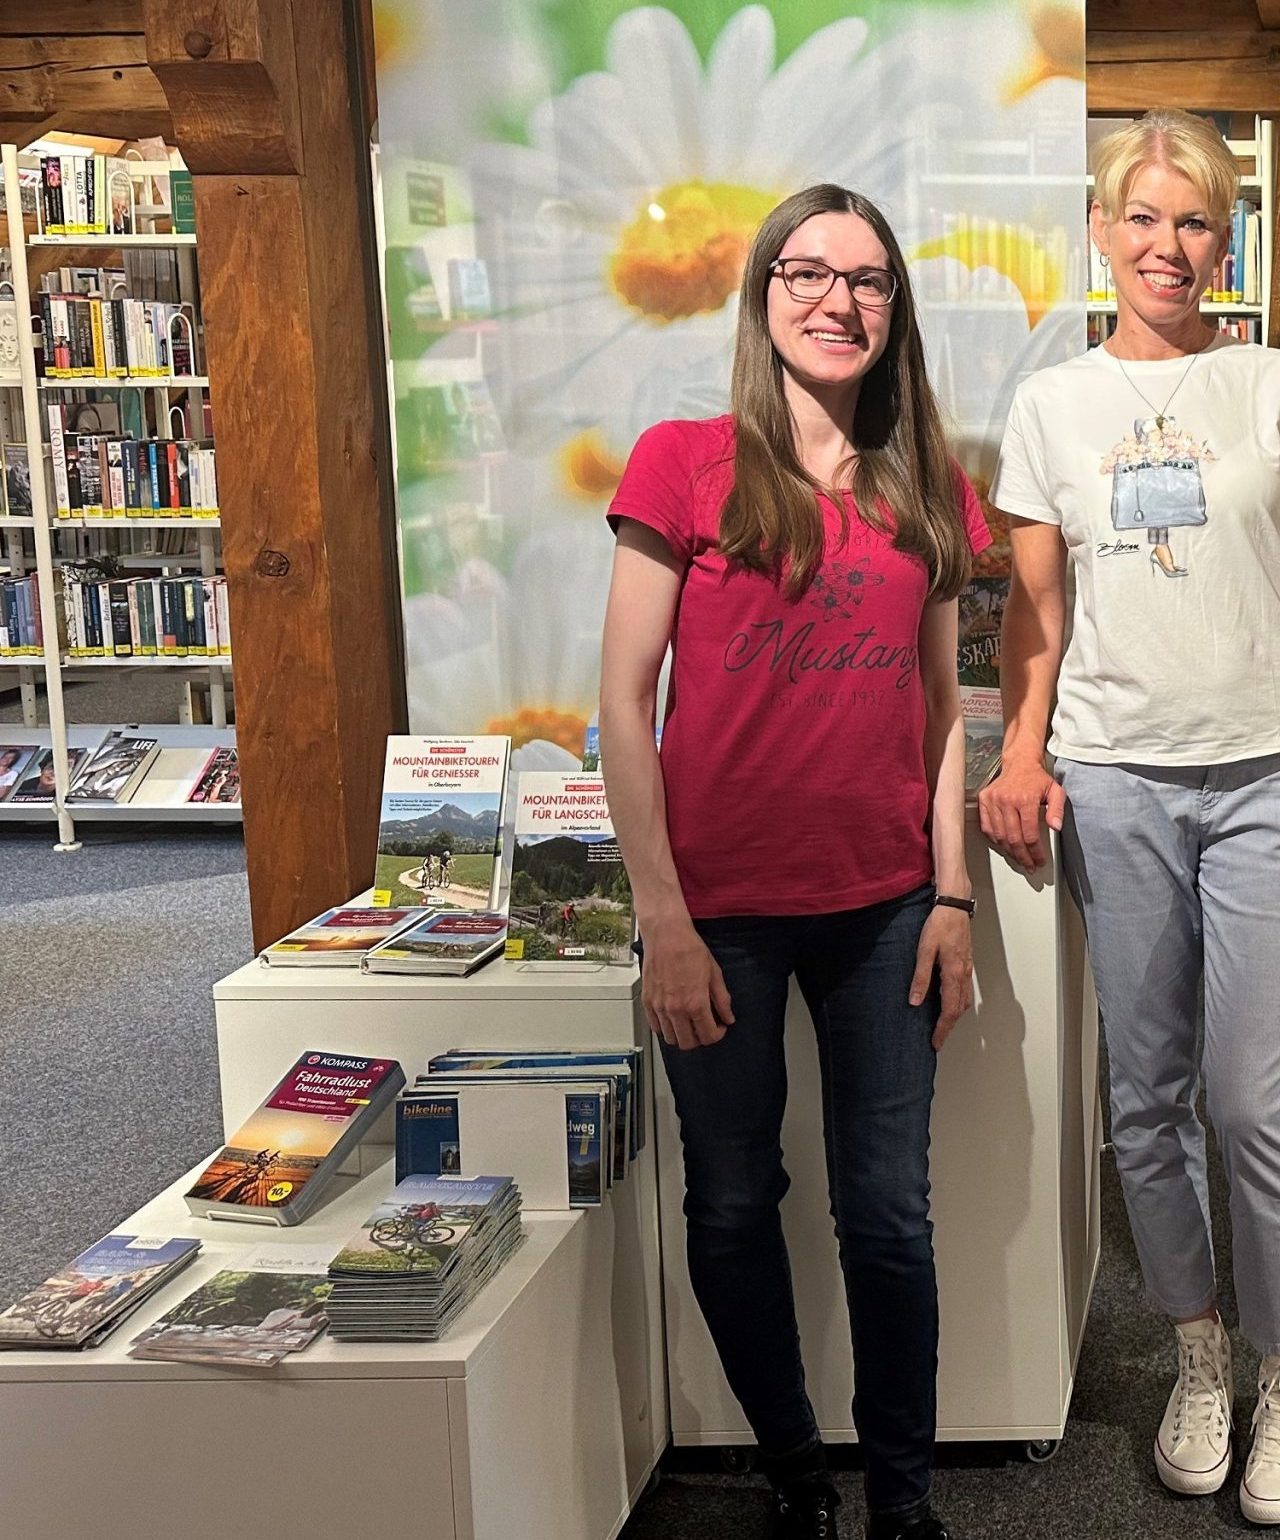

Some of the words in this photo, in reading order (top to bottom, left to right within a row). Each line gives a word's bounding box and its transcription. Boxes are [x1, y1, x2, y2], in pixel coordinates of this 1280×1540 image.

[50, 428, 63, 468] ROMY
[723, 619, 918, 690] Mustang
[132, 740, 155, 750] LIFE
[393, 757, 500, 766] MOUNTAINBIKETOUREN
[412, 767, 429, 778] FÜR
[431, 769, 480, 778] GENIESSER
[532, 807, 552, 819] FÜR
[320, 1057, 367, 1070] KOMPASS
[296, 1070, 372, 1088] Fahrradlust
[295, 1082, 358, 1097] Deutschland
[403, 1103, 453, 1116] bikeline
